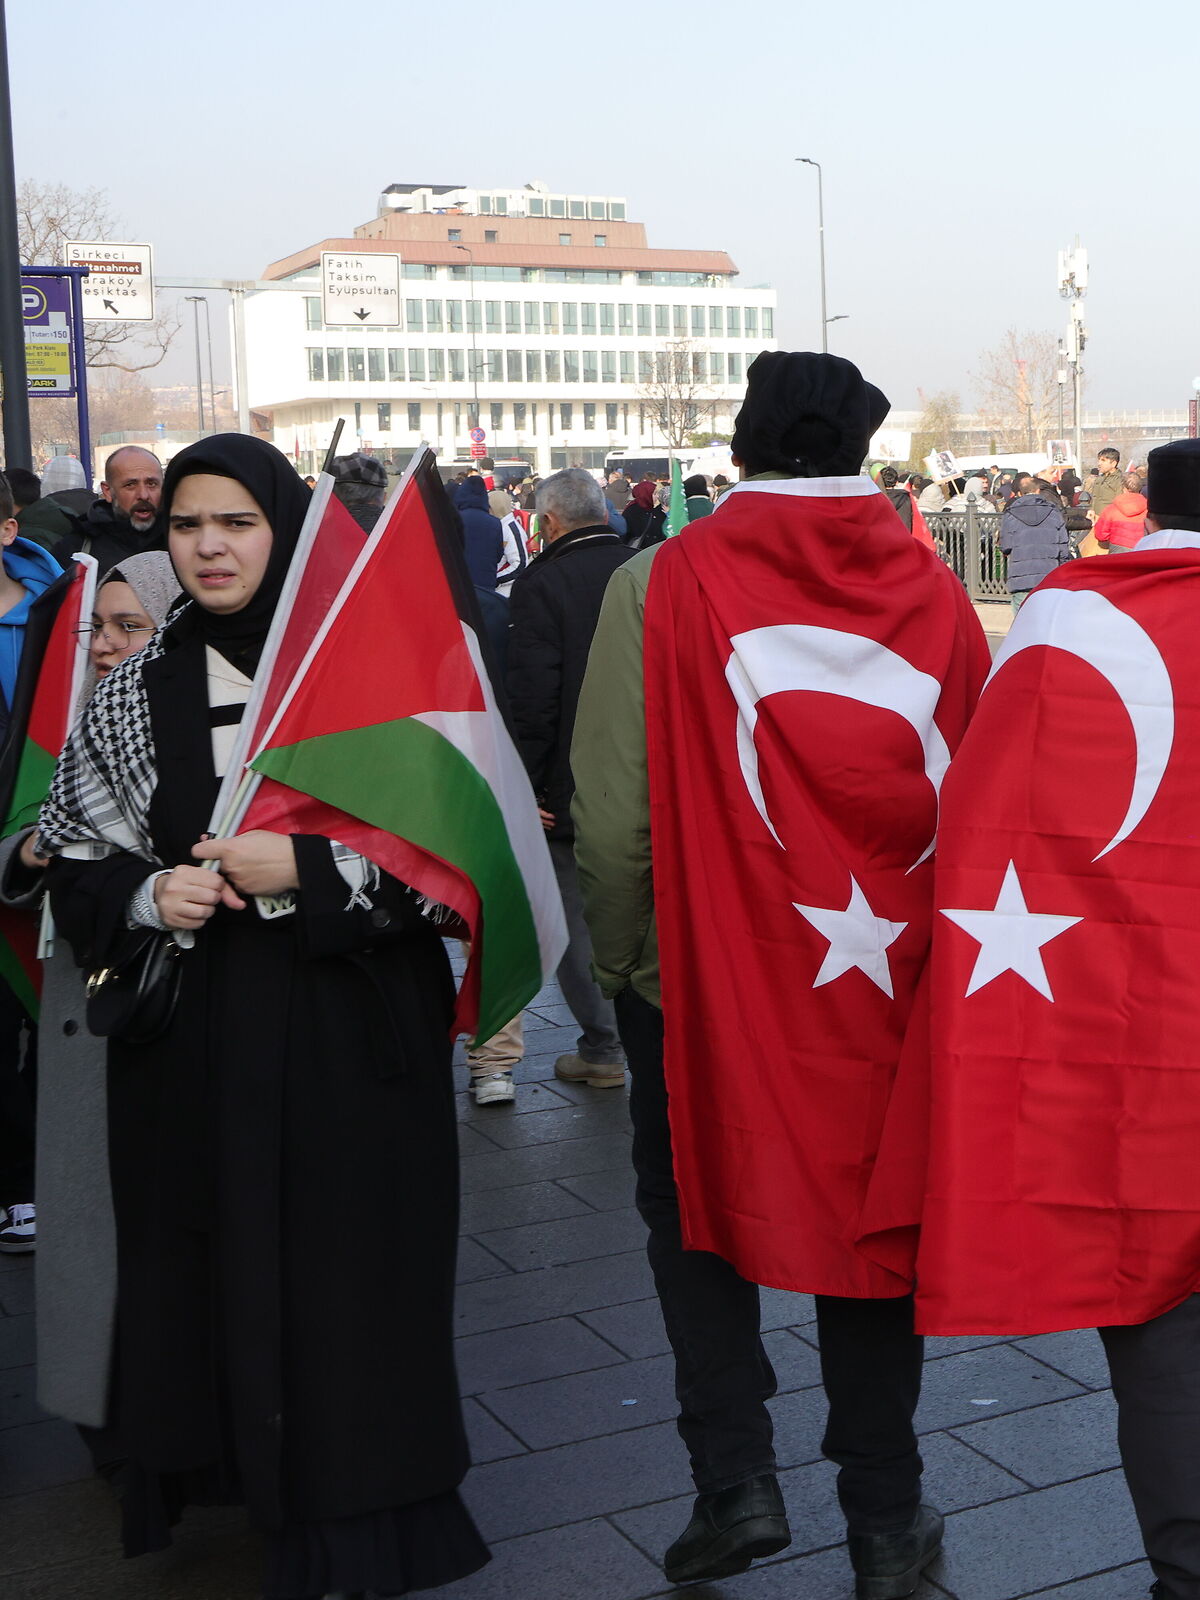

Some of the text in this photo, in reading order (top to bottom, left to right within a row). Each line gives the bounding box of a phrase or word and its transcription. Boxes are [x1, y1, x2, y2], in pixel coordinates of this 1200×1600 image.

[72, 249, 125, 259] Sirkeci
[72, 262, 139, 272] Stanahmet
[328, 259, 363, 268] Fatih
[83, 276, 133, 287] araköy
[329, 272, 377, 281] Taksim
[84, 286, 138, 296] eşiktaş
[328, 285, 397, 296] Eyüpsultan
